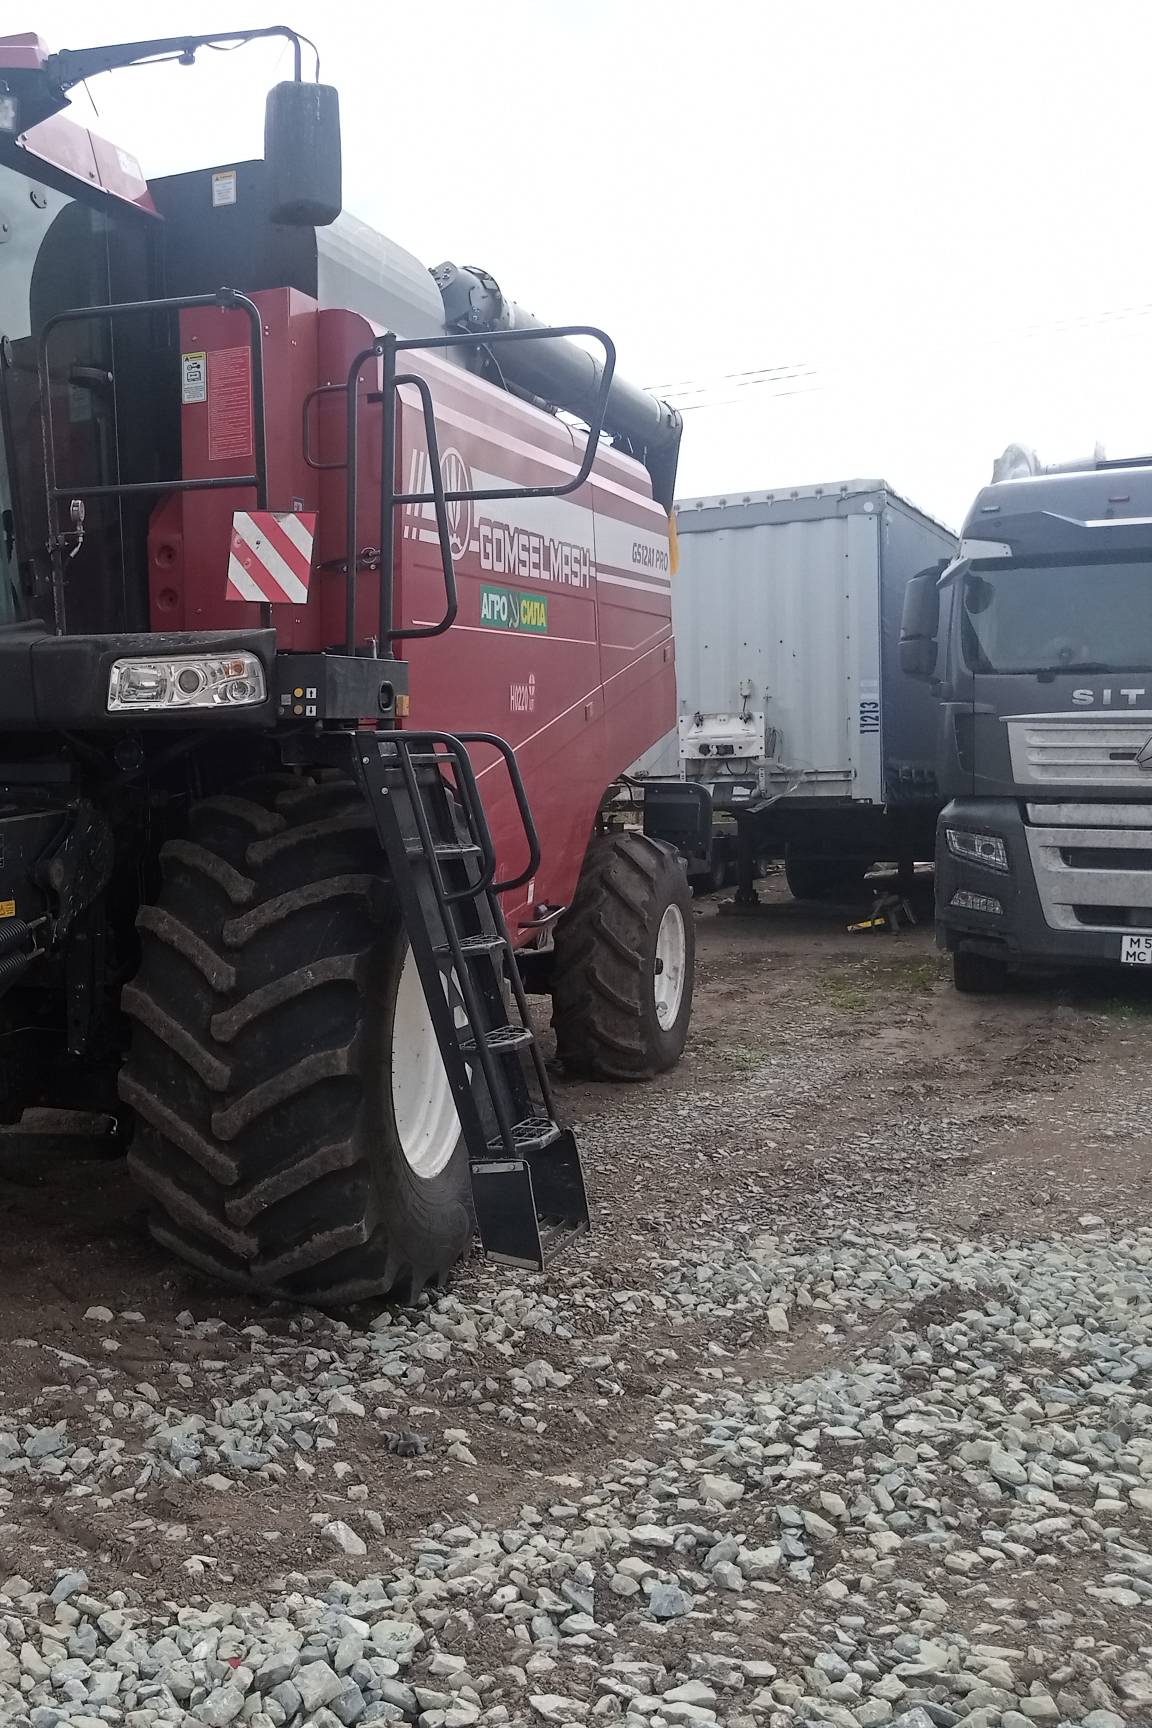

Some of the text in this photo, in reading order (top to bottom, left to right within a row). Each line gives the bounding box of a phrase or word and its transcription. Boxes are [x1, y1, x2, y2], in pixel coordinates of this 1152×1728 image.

[479, 518, 590, 589] GOMSELMASH
[655, 549, 669, 572] PRO
[481, 592, 508, 622] АГРО
[1071, 688, 1146, 706] SIT
[859, 701, 880, 735] 11213
[1126, 950, 1147, 962] MC
